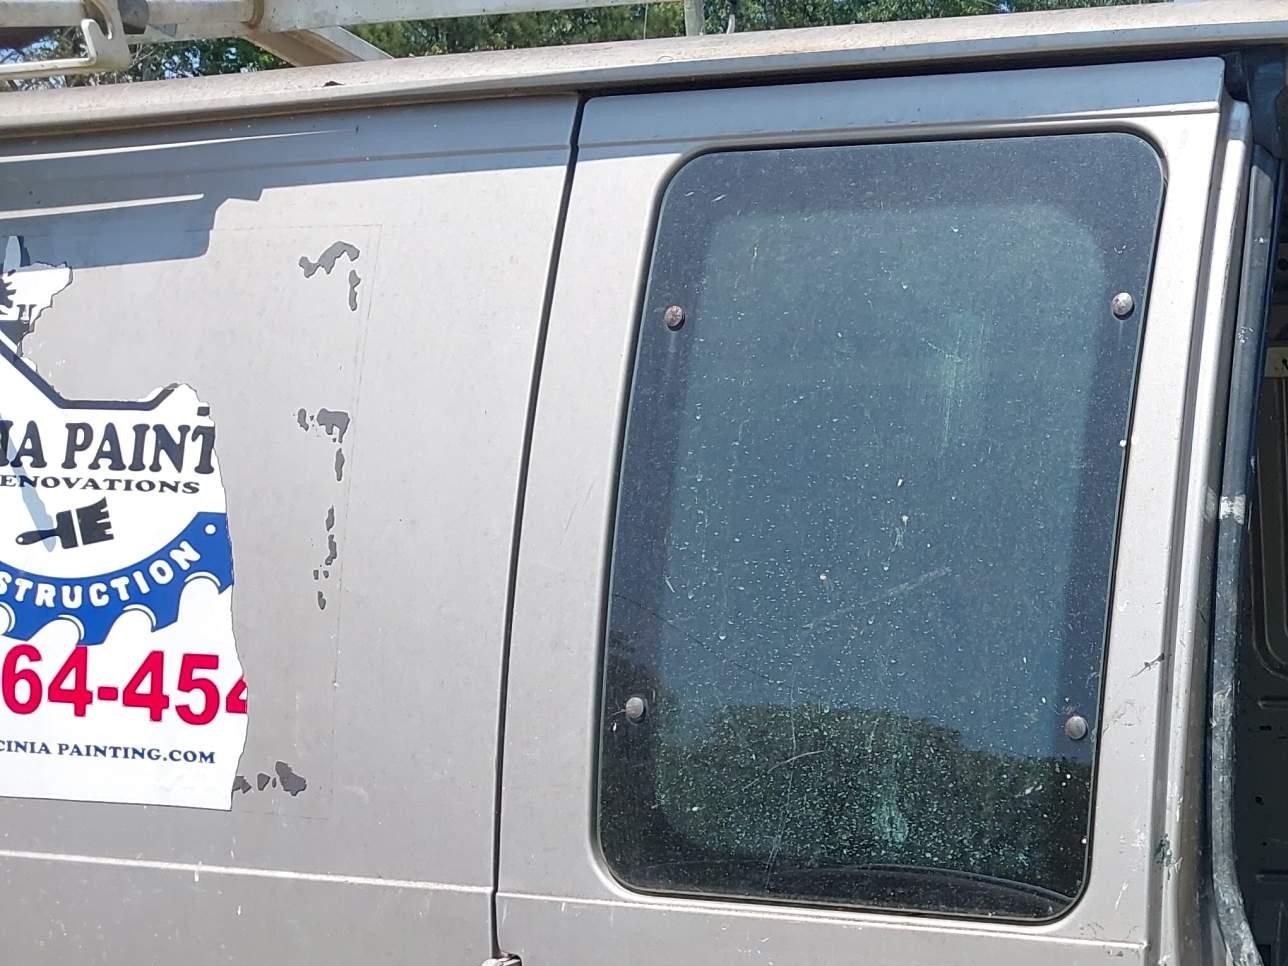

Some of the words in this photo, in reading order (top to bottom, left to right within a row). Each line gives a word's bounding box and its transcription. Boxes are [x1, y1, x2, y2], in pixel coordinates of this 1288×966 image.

[61, 422, 215, 474] PAINT
[0, 475, 200, 494] ENOVATIONS
[58, 743, 215, 764] PAINTING.COM
